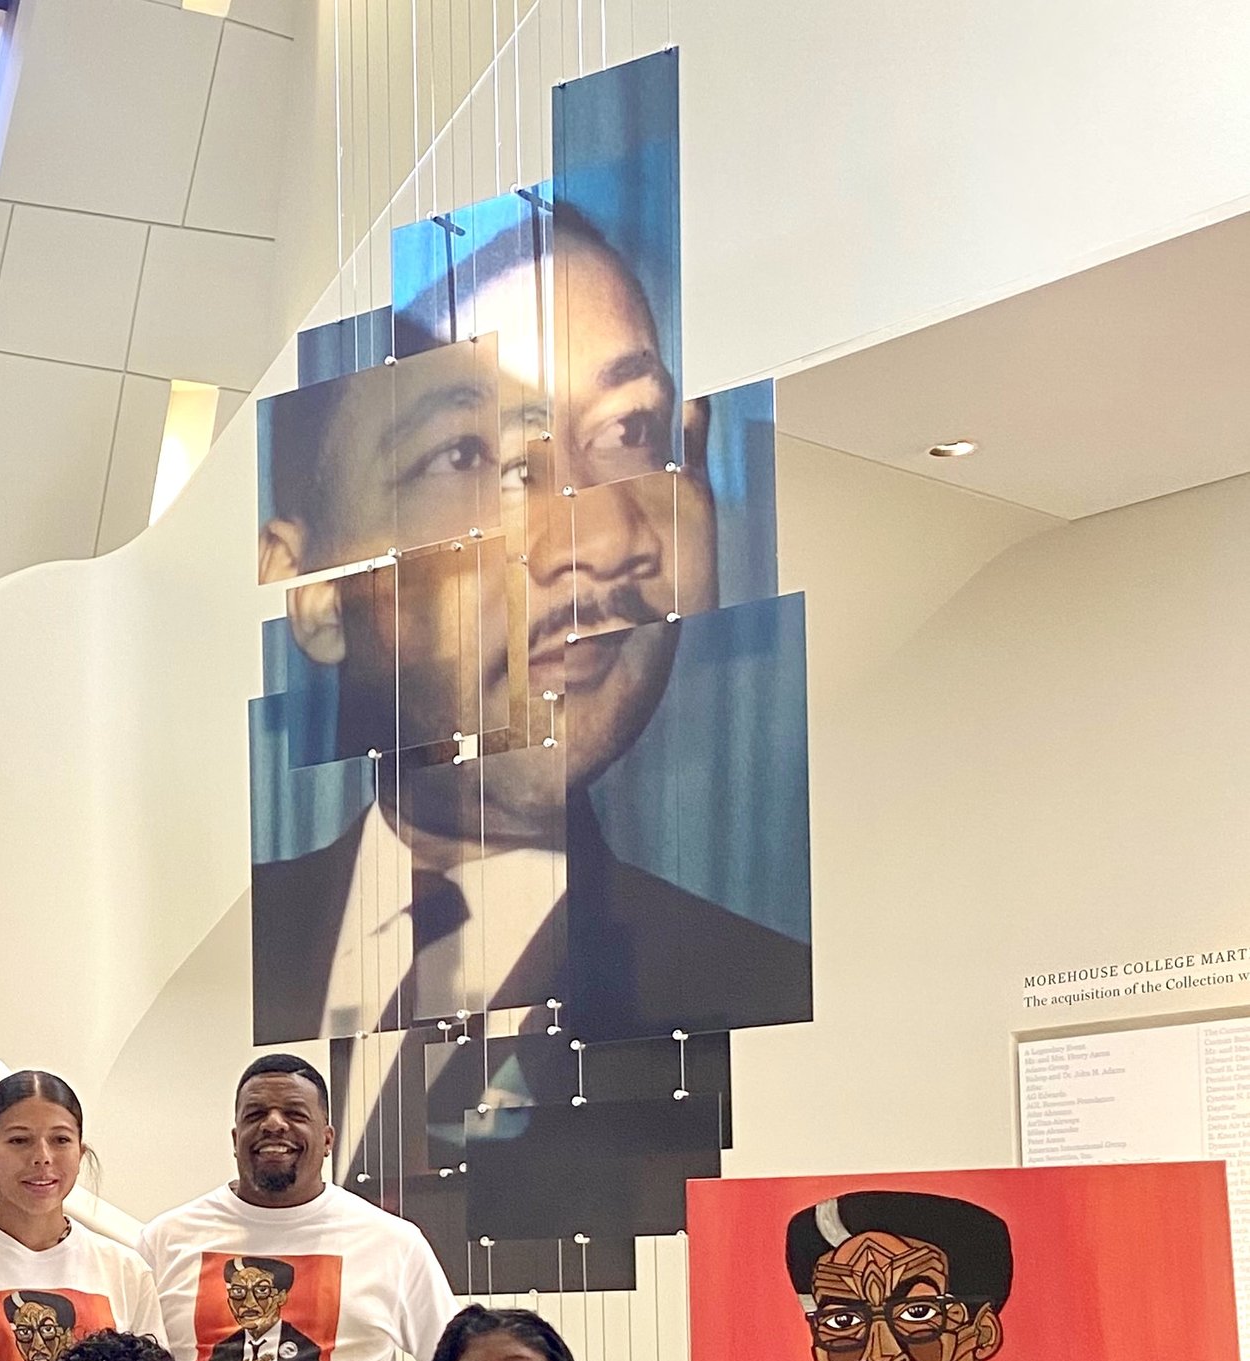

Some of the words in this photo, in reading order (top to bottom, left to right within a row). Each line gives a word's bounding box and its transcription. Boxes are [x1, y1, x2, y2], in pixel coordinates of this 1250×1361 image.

[1024, 965, 1119, 989] MOREHOUSE
[1123, 955, 1195, 975] COLLEGE
[1201, 948, 1250, 966] MART
[1023, 995, 1048, 1008] The
[1051, 987, 1120, 1006] acquisition
[1124, 982, 1139, 996] of
[1141, 981, 1162, 993] the
[1166, 972, 1234, 990] Collection
